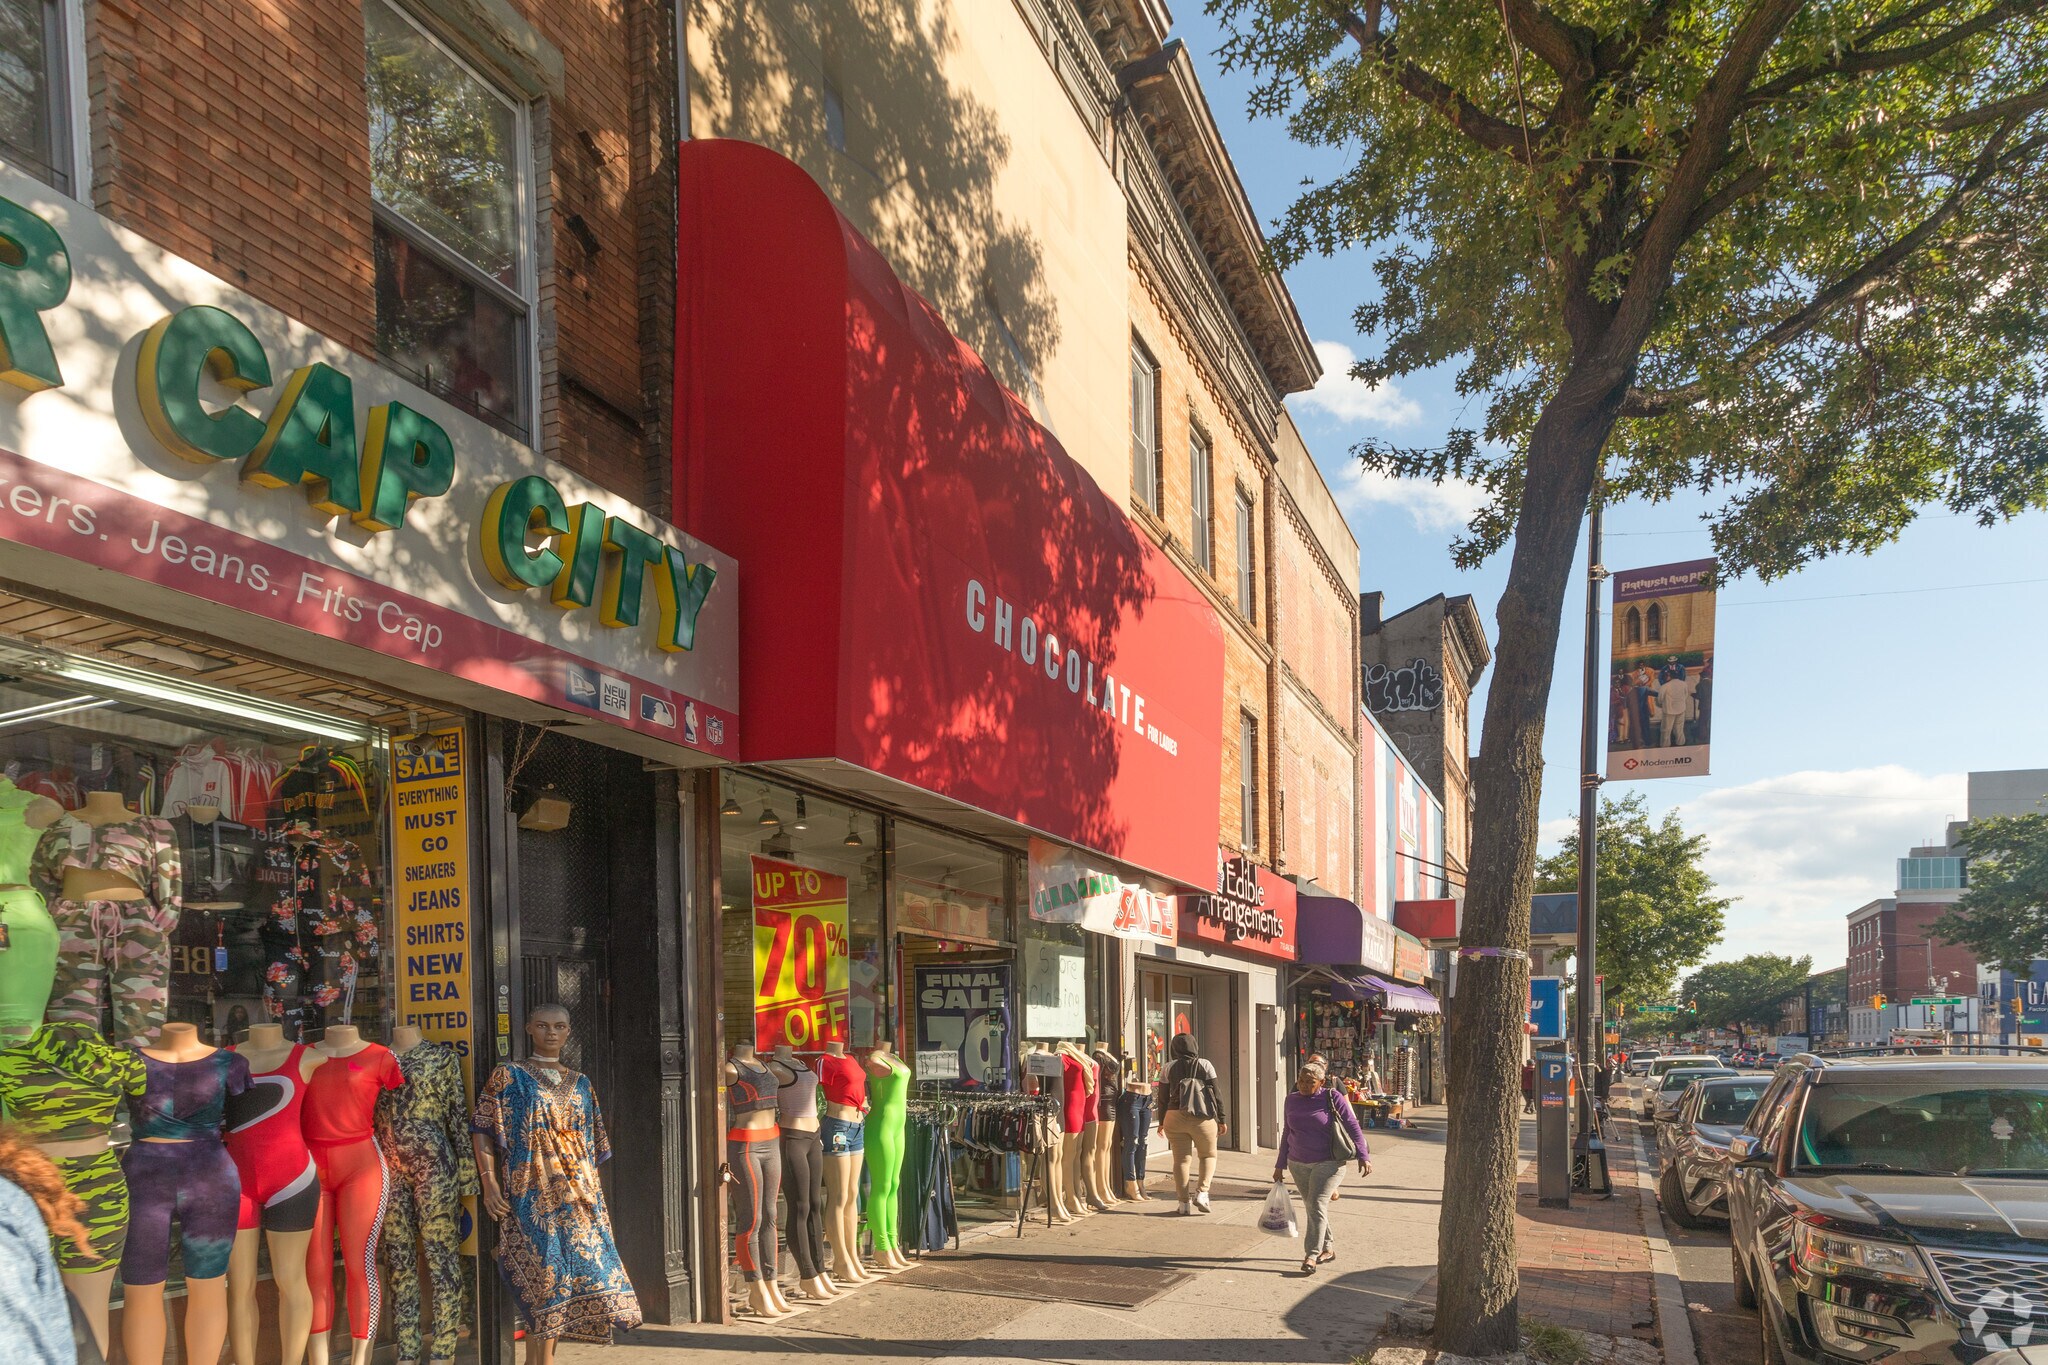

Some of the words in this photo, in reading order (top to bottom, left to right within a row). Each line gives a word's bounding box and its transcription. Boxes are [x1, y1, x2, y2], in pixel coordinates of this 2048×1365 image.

[137, 305, 456, 532] CAP
[481, 475, 716, 653] CITY
[0, 482, 108, 540] ers.
[131, 519, 279, 596] Jeans.
[296, 571, 364, 622] Fits
[377, 601, 443, 653] Cap
[1669, 574, 1688, 584] Ave
[966, 579, 1145, 736] CHOCOLATE
[1147, 723, 1158, 745] FOR
[604, 682, 627, 699] NEW
[604, 695, 627, 711] ERA
[707, 727, 723, 742] NFL
[397, 752, 459, 779] SALE
[1640, 757, 1692, 767] ModernMD
[398, 785, 458, 806] EVERYTHING
[405, 810, 457, 830] MUST
[421, 836, 448, 852] GO
[405, 861, 456, 882] SNEAKERS
[756, 867, 785, 899] UP
[790, 870, 821, 896] TO
[1226, 857, 1265, 907] Edible
[408, 887, 460, 912] JEANS
[1034, 873, 1118, 916] CLEAANCE
[1113, 885, 1173, 940] SALE
[1199, 893, 1284, 941] Arrangements
[406, 921, 464, 946] SHIRTS
[408, 952, 463, 977] NEW
[755, 907, 848, 1001] 70%
[410, 981, 460, 1002] ERA
[926, 973, 1000, 987] FINAL
[921, 987, 1005, 1009] SALE
[1029, 983, 1080, 1017] Closing
[406, 1011, 467, 1031] FITTED
[784, 1000, 845, 1047] OFF
[1550, 1063, 1562, 1079] P
